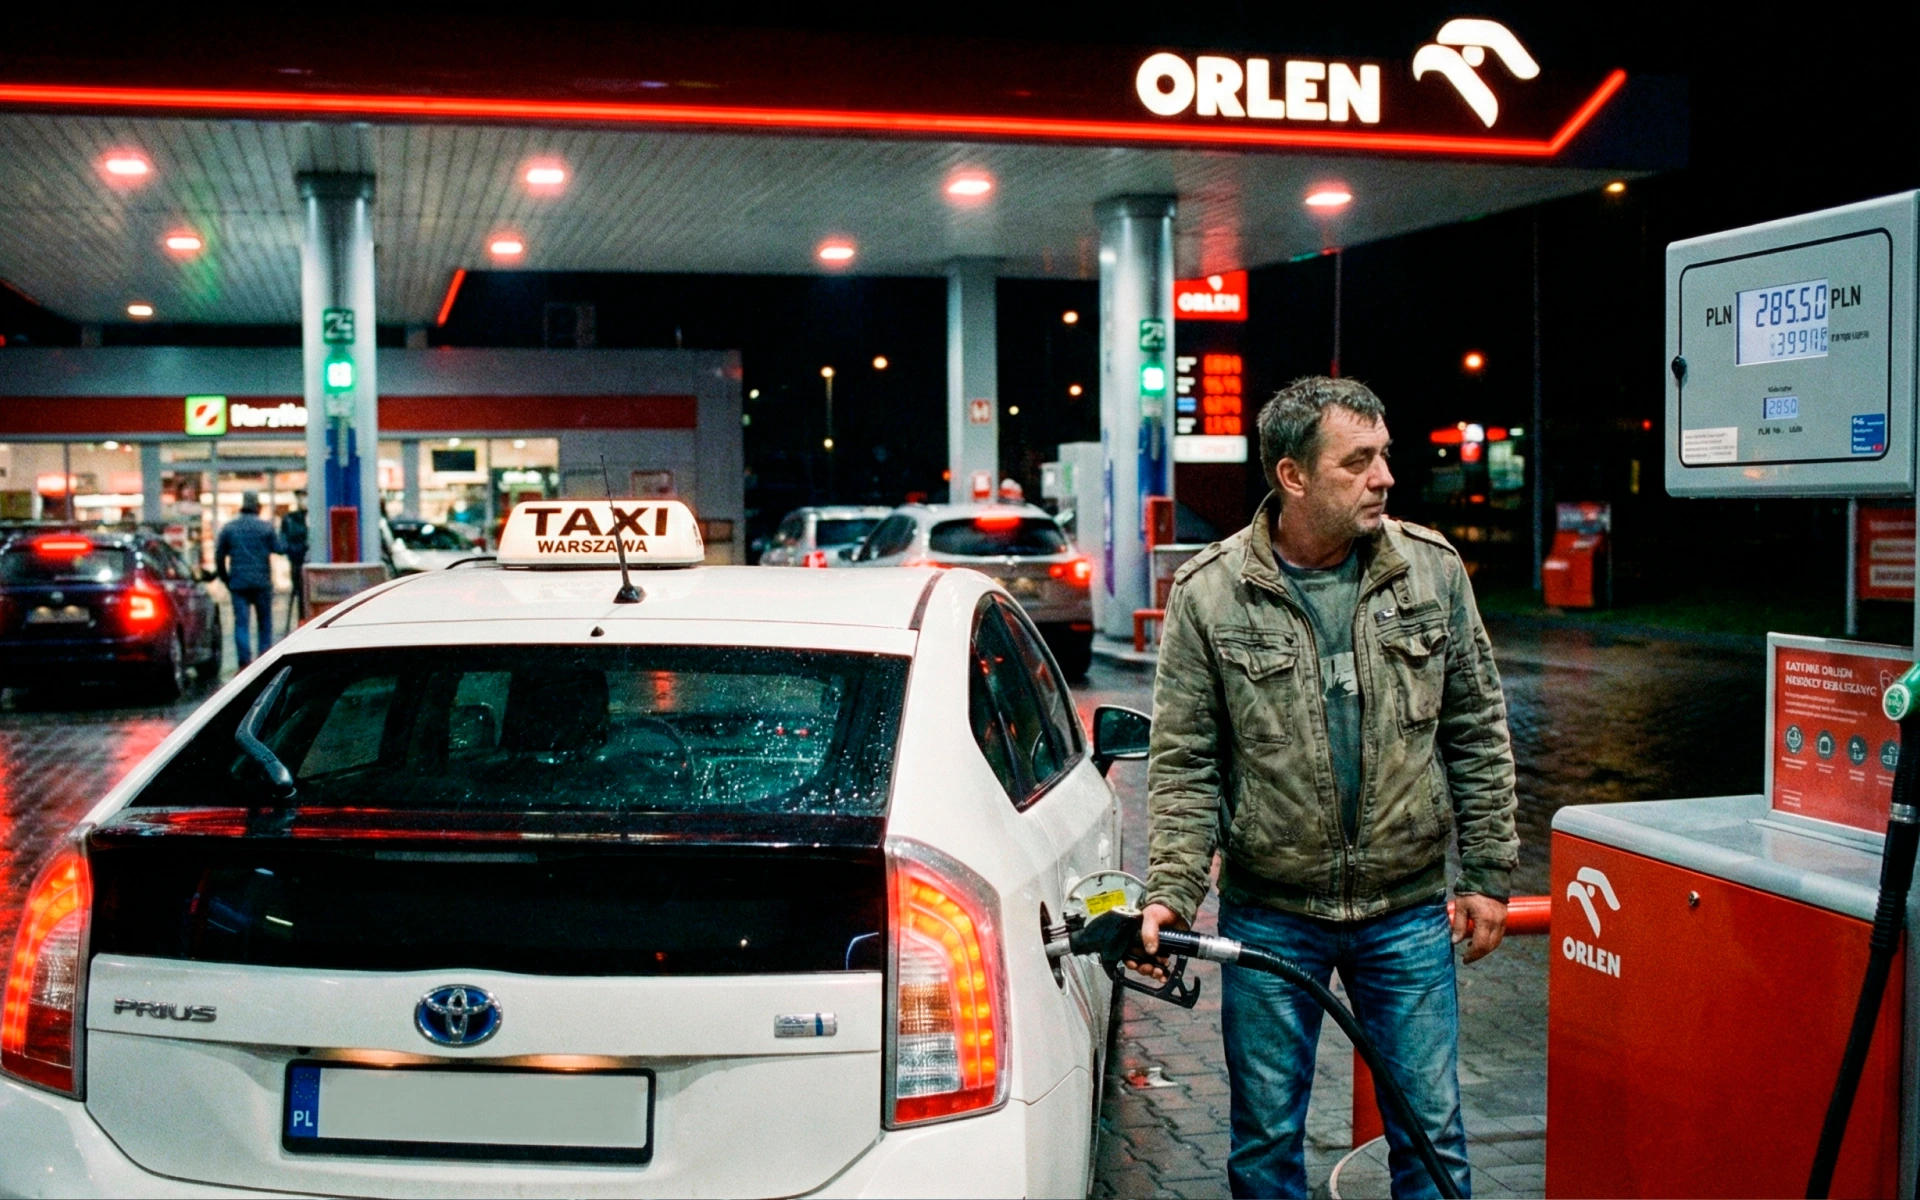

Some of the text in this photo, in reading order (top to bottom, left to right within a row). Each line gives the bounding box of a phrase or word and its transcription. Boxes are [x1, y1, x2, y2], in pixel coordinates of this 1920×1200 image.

[1136, 52, 1380, 123] ORLEN
[1756, 284, 1827, 328] 285.50
[1831, 285, 1861, 309] PLN
[1706, 305, 1732, 327] PLN
[524, 507, 669, 536] TAXI
[538, 539, 649, 553] WARSZAWA
[1563, 936, 1621, 978] ORLEN
[114, 998, 217, 1023] PRIUS
[293, 1110, 314, 1127] PL
